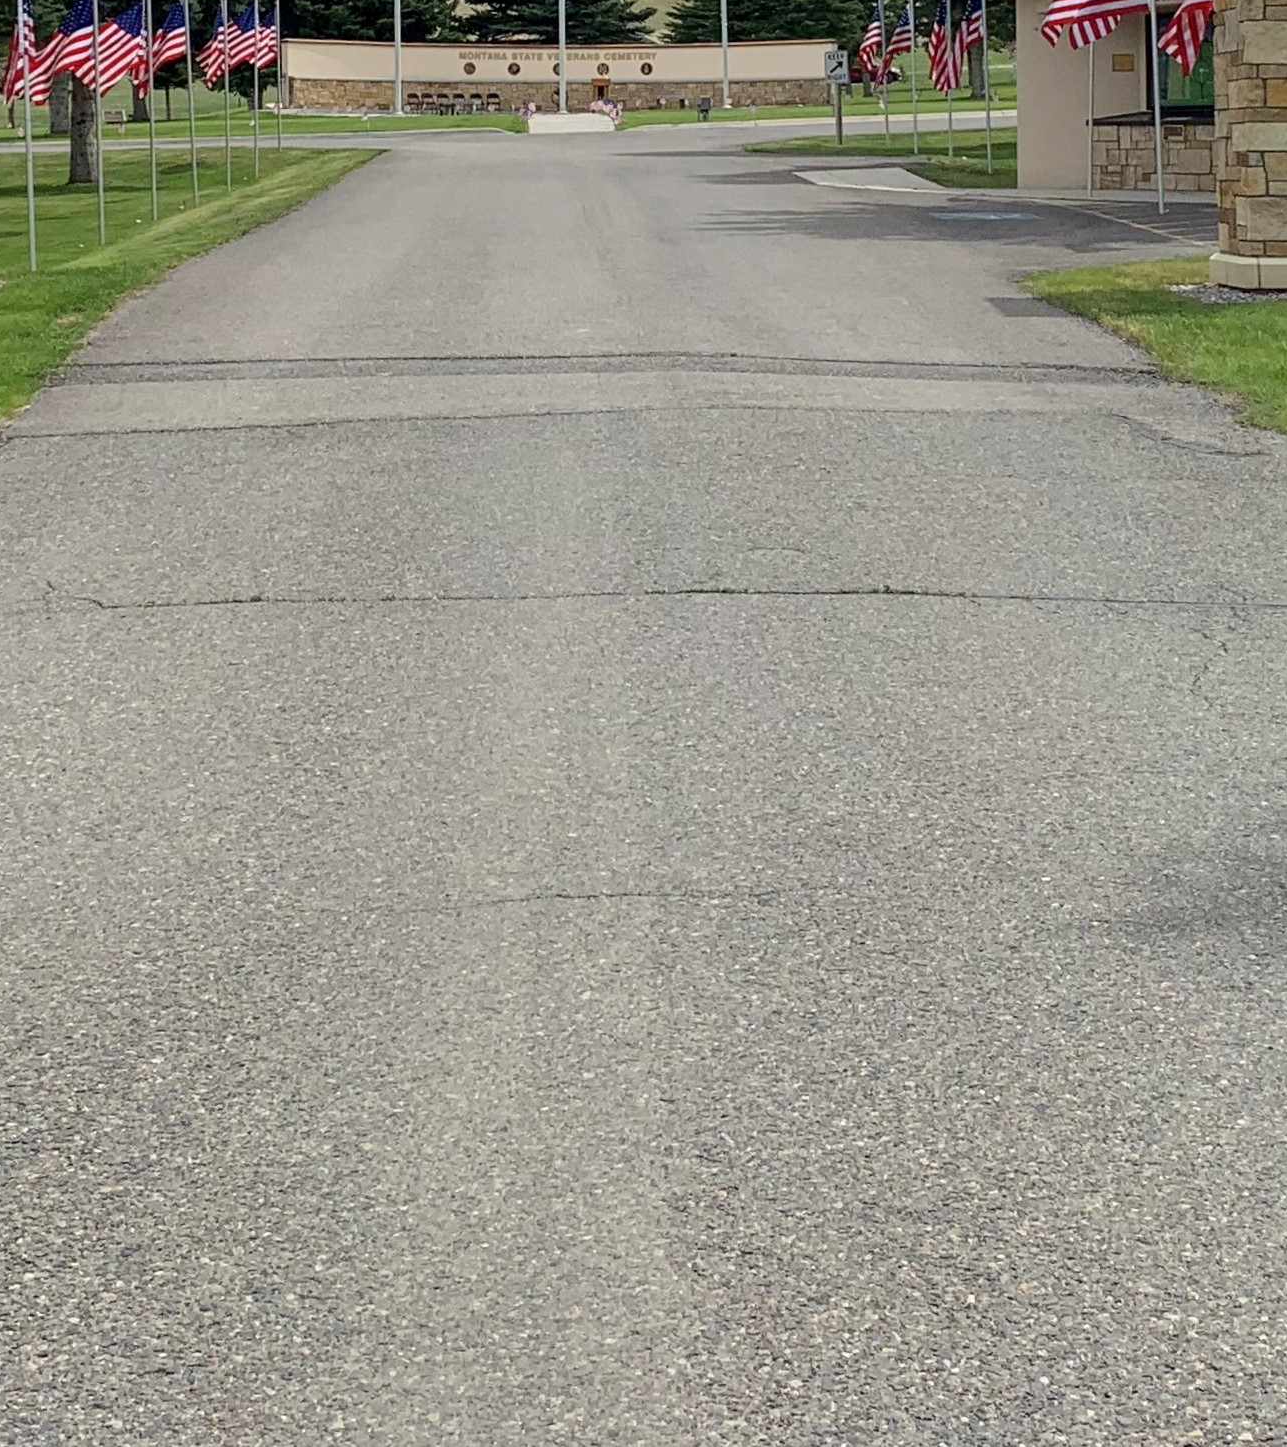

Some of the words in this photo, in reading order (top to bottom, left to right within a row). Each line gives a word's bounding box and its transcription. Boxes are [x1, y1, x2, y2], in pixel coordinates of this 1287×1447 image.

[459, 52, 507, 61] MONTANA
[511, 52, 543, 61] STATE
[547, 52, 600, 61] VEERANS
[604, 52, 657, 61] CEMETERY
